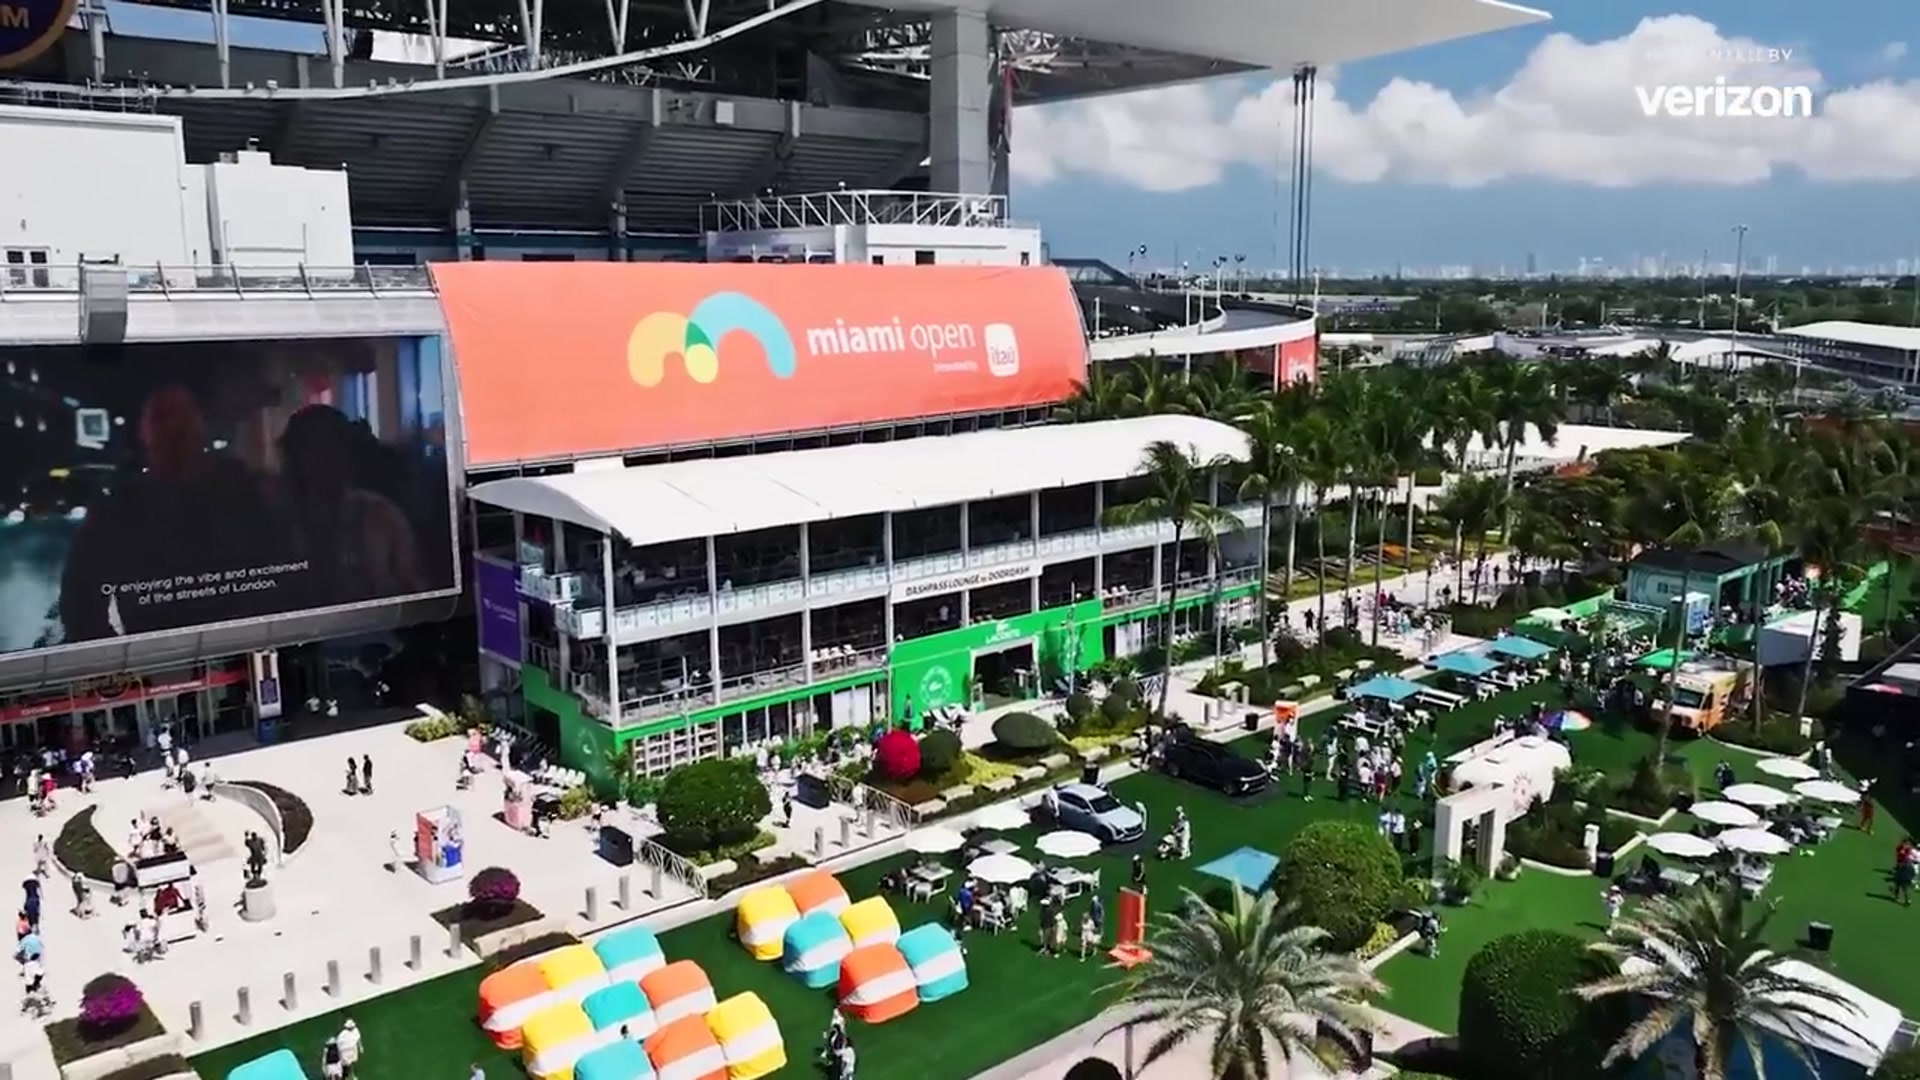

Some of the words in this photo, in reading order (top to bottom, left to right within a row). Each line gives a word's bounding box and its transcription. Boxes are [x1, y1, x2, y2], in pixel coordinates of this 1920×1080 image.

[806, 316, 905, 356] miami
[910, 323, 976, 359] open
[101, 583, 118, 595] Or
[120, 578, 173, 594] enjoying
[175, 575, 195, 586] the
[197, 572, 222, 584] vibe
[225, 568, 247, 580] and
[249, 560, 310, 576] excitement
[139, 594, 151, 605] of
[153, 591, 174, 604] the
[176, 585, 217, 600] streets
[219, 583, 231, 595] of
[232, 579, 279, 593] London.
[948, 574, 981, 589] LOUNGE
